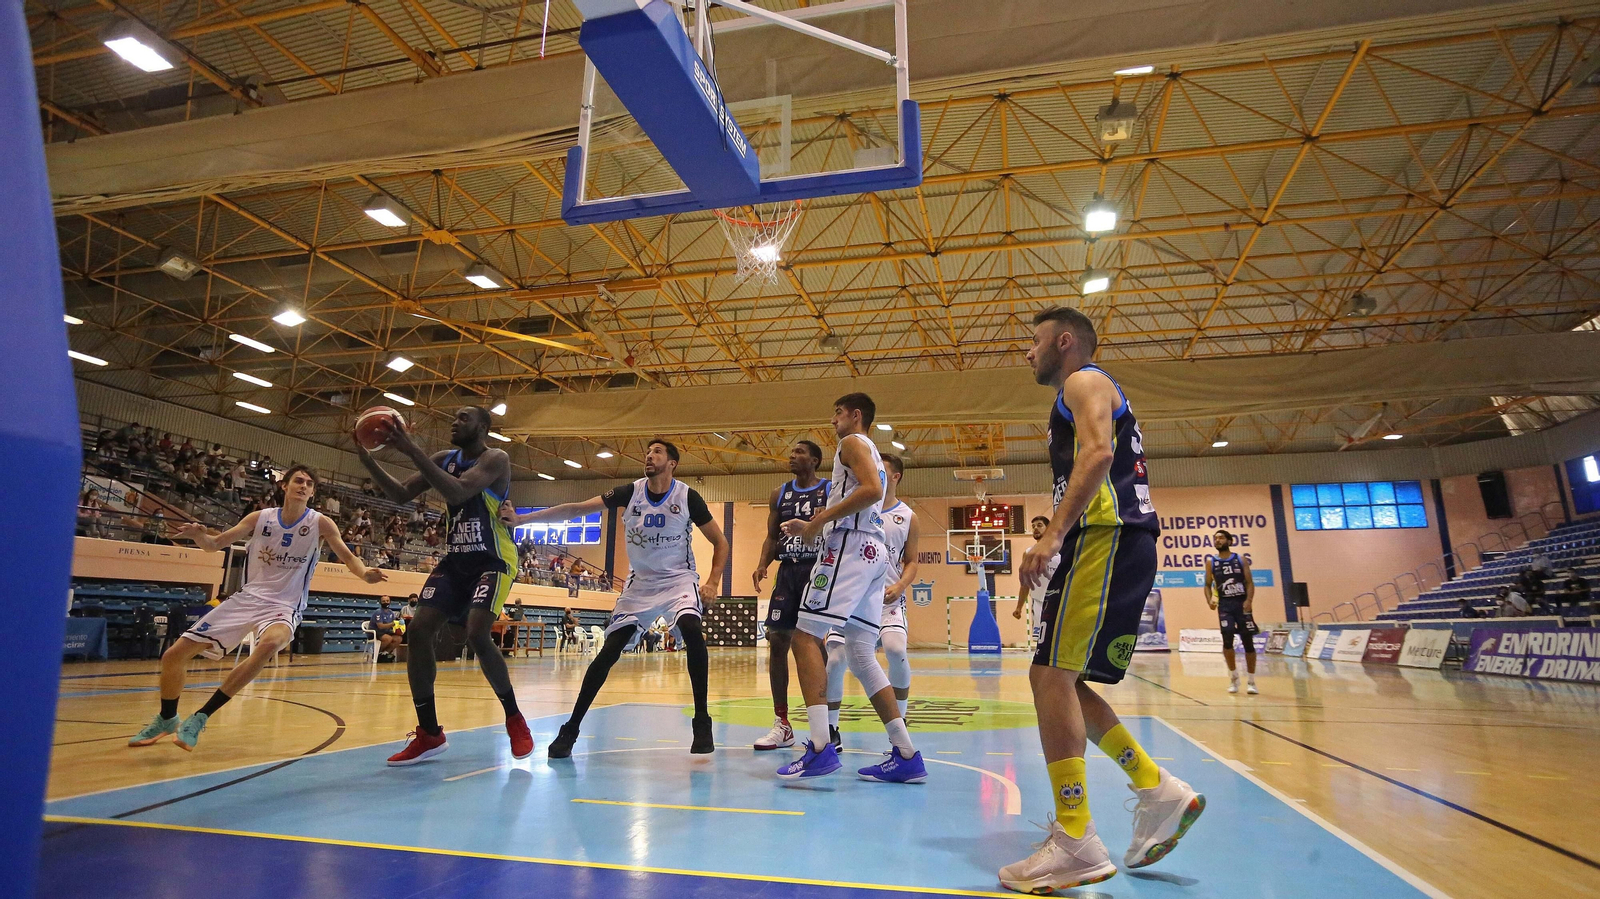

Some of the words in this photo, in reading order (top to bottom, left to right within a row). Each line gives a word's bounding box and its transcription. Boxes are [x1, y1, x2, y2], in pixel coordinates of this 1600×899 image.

[794, 501, 812, 517] 14
[643, 513, 666, 528] 00
[1160, 514, 1267, 530] LIDEPORTIVO
[282, 533, 293, 547] 5
[1163, 534, 1216, 549] CIUDA
[1231, 533, 1250, 547] DE
[118, 547, 150, 557] PRENSA
[917, 551, 941, 564] AMIENTO
[1163, 553, 1252, 568] ALGECS
[1222, 565, 1233, 575] 21
[473, 584, 489, 598] 12
[196, 621, 212, 633] 5
[1245, 620, 1255, 629] 21
